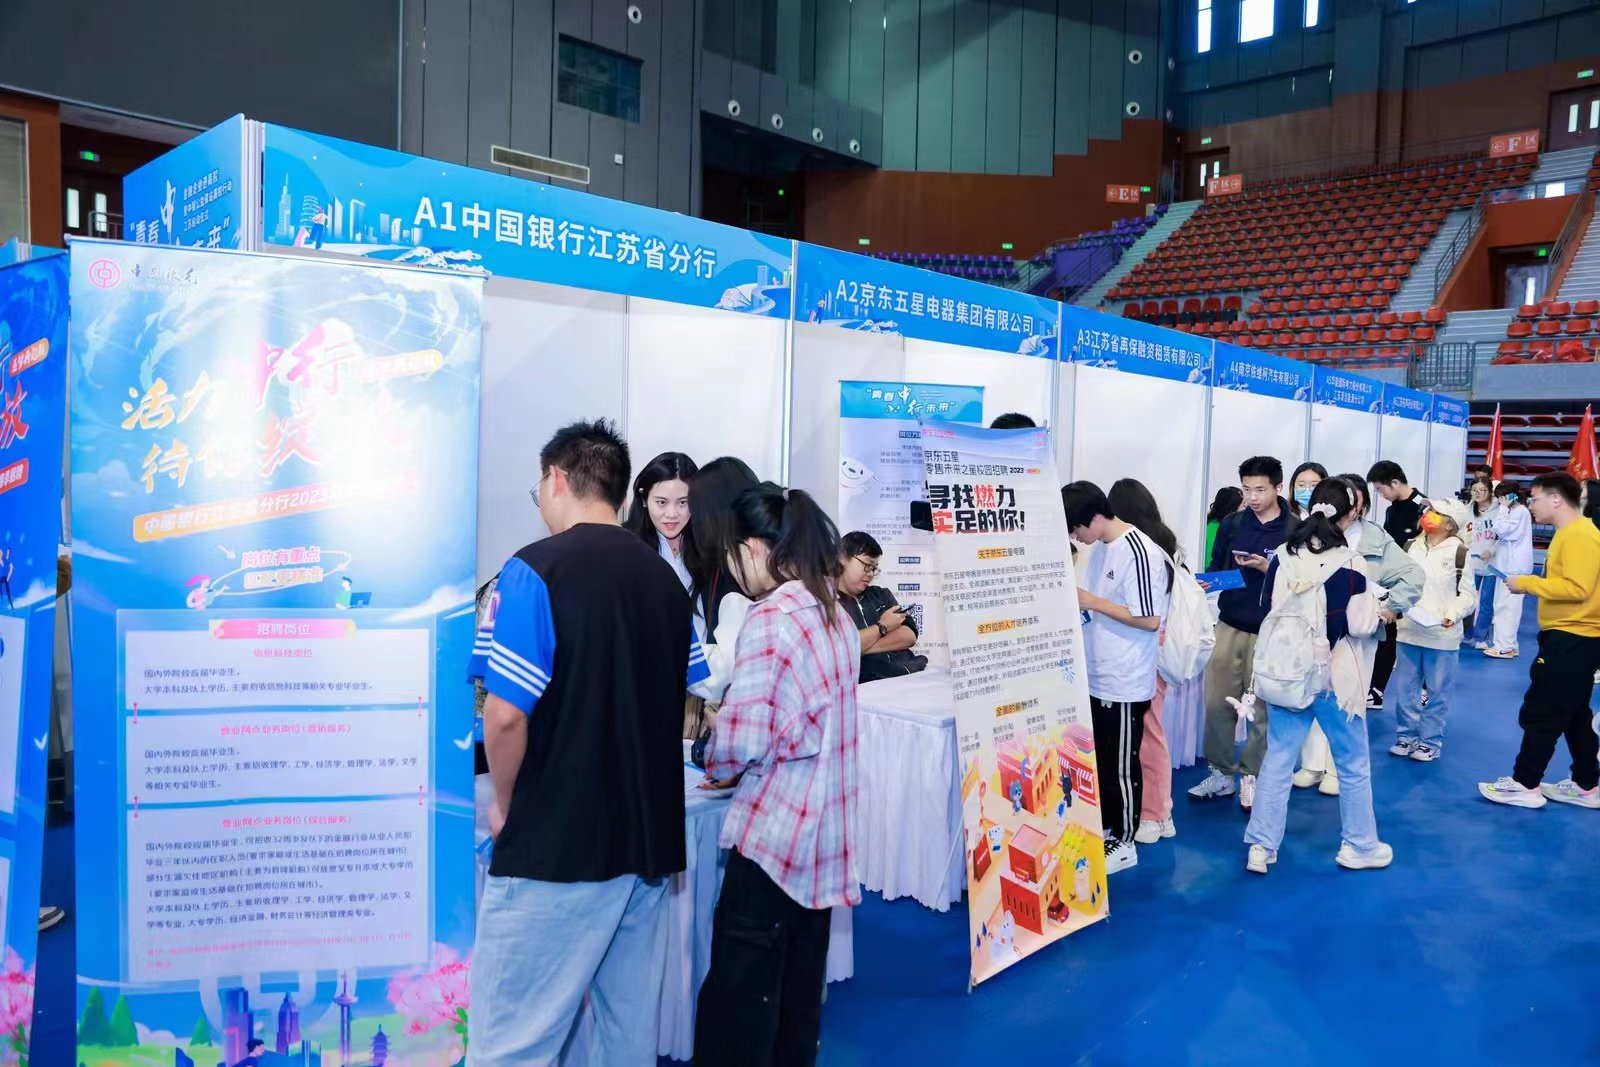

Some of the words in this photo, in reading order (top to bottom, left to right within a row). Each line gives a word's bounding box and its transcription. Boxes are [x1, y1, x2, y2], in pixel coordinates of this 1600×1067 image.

[413, 195, 718, 280] A1中国银行江苏省分行
[836, 279, 1034, 336] A2京东五星电器集团有限公司
[1077, 328, 1201, 369] A3江苏省再保融资租赁有限公司
[924, 450, 960, 463] 京东五星
[925, 462, 1009, 477] 零售未来之星校园招聘
[928, 483, 1016, 509] 寻找燃力
[242, 546, 320, 568] 岗位有重点
[978, 546, 1025, 560] 关于京东五星电器
[256, 623, 311, 636] 招聘岗位
[978, 615, 1040, 634] 全方位的人才培养体系
[253, 647, 313, 658] 信息科技岗位
[144, 667, 240, 679] 国内外院校应届毕业生。
[144, 747, 241, 759] 国内外院校应届毕业生。
[144, 779, 222, 791] 等相关专业毕业生。
